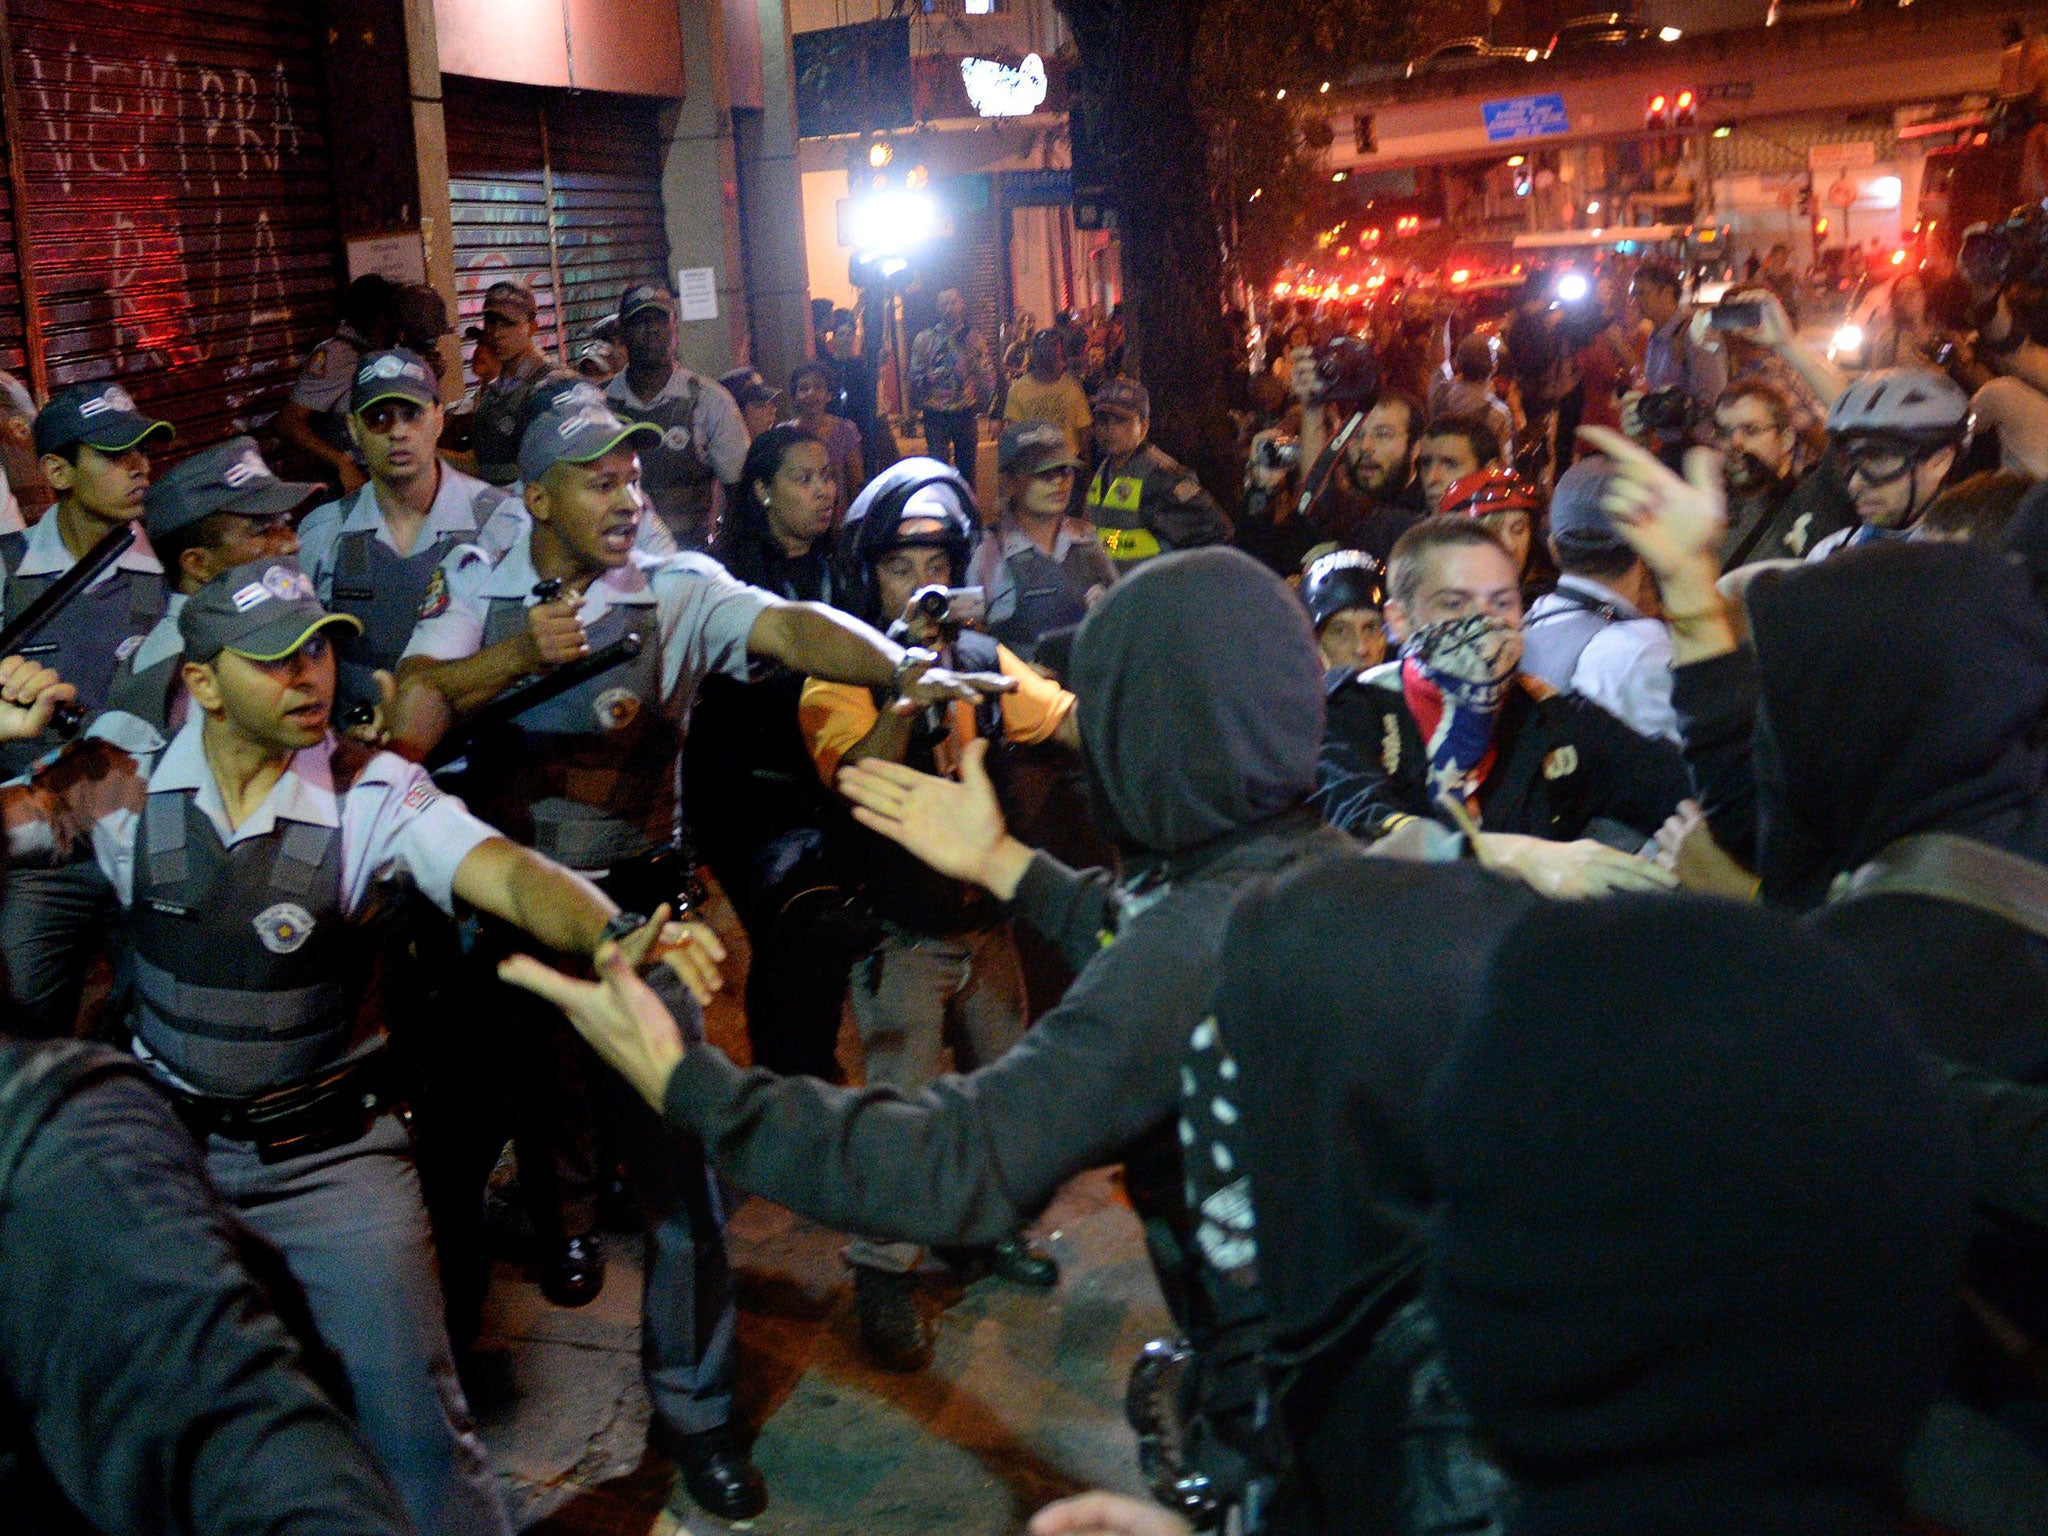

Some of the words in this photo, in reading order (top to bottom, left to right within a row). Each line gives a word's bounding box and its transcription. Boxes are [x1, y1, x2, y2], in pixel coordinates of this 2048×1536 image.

[21, 41, 191, 194] VEM
[199, 61, 299, 197] PRA
[105, 209, 299, 368] RUA
